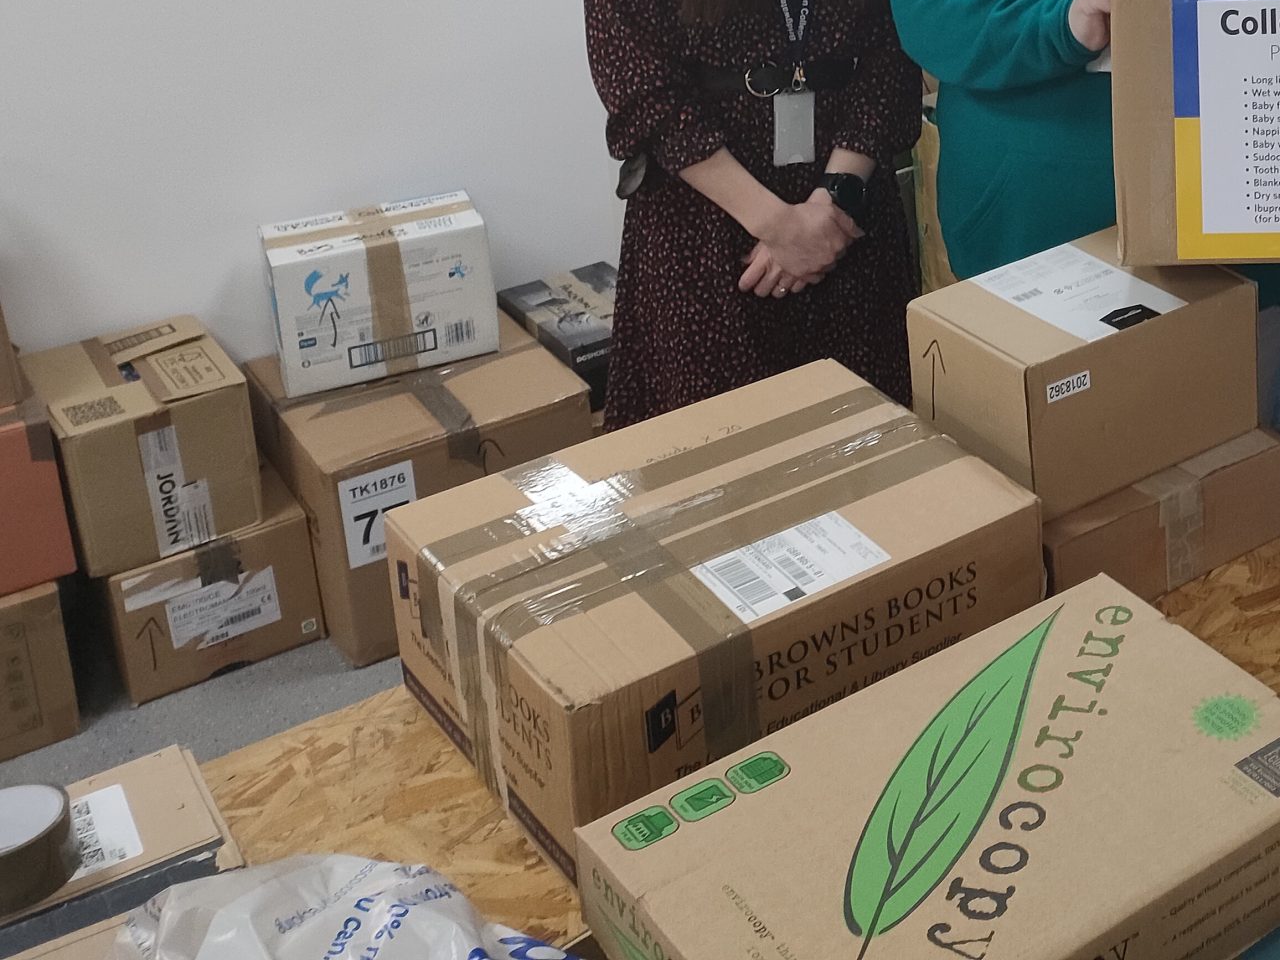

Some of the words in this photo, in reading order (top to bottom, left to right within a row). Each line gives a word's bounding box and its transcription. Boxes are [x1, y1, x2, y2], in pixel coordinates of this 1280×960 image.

[1251, 75, 1274, 86] Long
[1251, 88, 1271, 98] Wet
[1251, 100, 1275, 112] Baby
[1252, 113, 1275, 125] Baby
[1252, 139, 1276, 151] Baby
[1253, 191, 1271, 202] Dry
[1253, 211, 1271, 224] (for
[1049, 373, 1088, 399] 2018362
[349, 473, 406, 499] TK1876
[157, 472, 182, 545] JORDAN
[353, 500, 411, 546] 7
[753, 607, 876, 682] BROWNS
[887, 560, 977, 620] BOOKS
[826, 586, 979, 676] STUDENTS
[767, 686, 847, 737] Educational
[863, 657, 908, 689] Library
[509, 684, 551, 744] OOKS
[927, 605, 1134, 960] envirocopy
[592, 868, 665, 960] enviro
